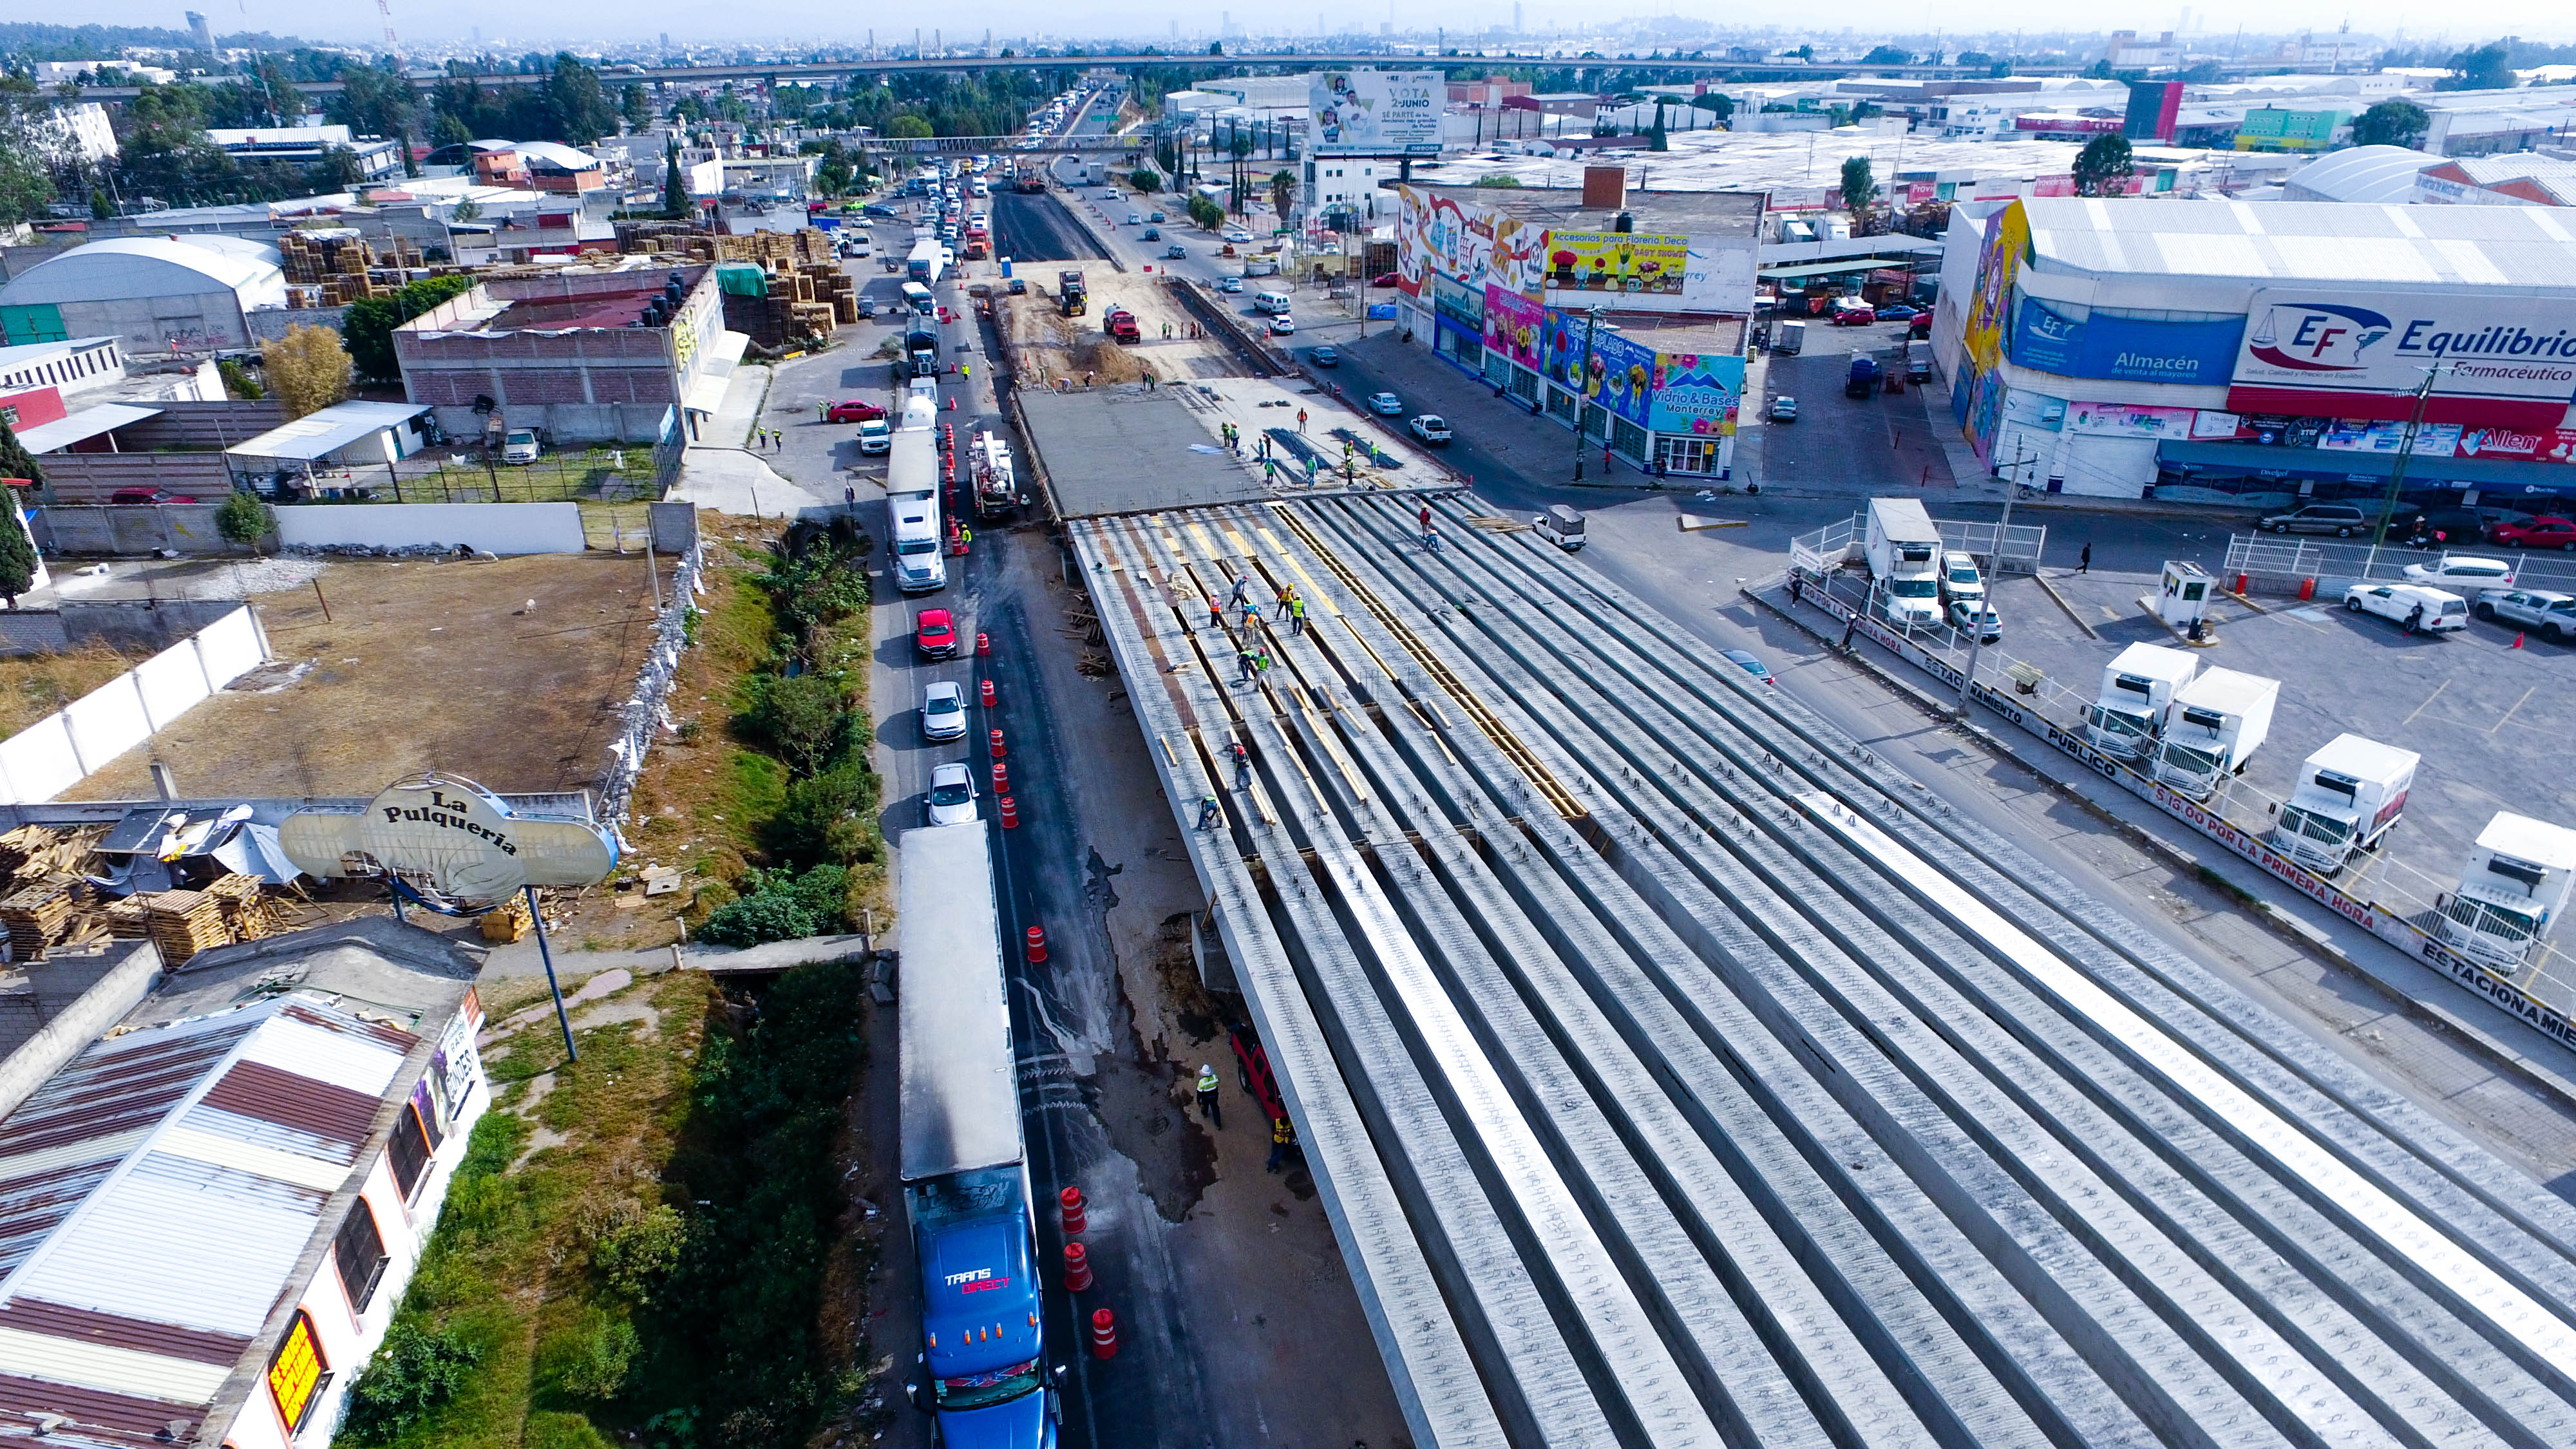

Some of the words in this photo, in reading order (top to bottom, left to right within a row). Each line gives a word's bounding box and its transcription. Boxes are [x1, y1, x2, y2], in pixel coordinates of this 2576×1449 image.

[1389, 88, 1430, 98] VOTA
[1553, 232, 1600, 242] Accesorios
[1664, 236, 1687, 245] Deco
[2043, 316, 2061, 334] EF
[2292, 316, 2347, 357] EF
[2398, 320, 2576, 357] Equilibrio
[2115, 352, 2199, 370] Almacén
[2451, 361, 2572, 381] Farmacéutico
[1652, 390, 1687, 403] Vidrio
[1690, 392, 1699, 404] &
[1702, 393, 1739, 406] Bases
[1666, 404, 1721, 417] Monterrey
[2480, 428, 2538, 450] Allen
[1833, 601, 1843, 618] LA
[1880, 634, 1902, 653] HORA
[1925, 657, 2022, 724] ESTACINAMIENTO
[2048, 728, 2116, 777] PUBLICO
[431, 791, 468, 813] La
[383, 806, 516, 856] Pulqueria
[2208, 819, 2237, 844] POR
[2238, 837, 2257, 858] LA
[2262, 852, 2326, 900] PRIMERA
[2331, 895, 2374, 929] HORA
[451, 1032, 465, 1052] BAR
[945, 1268, 991, 1286] TRANS
